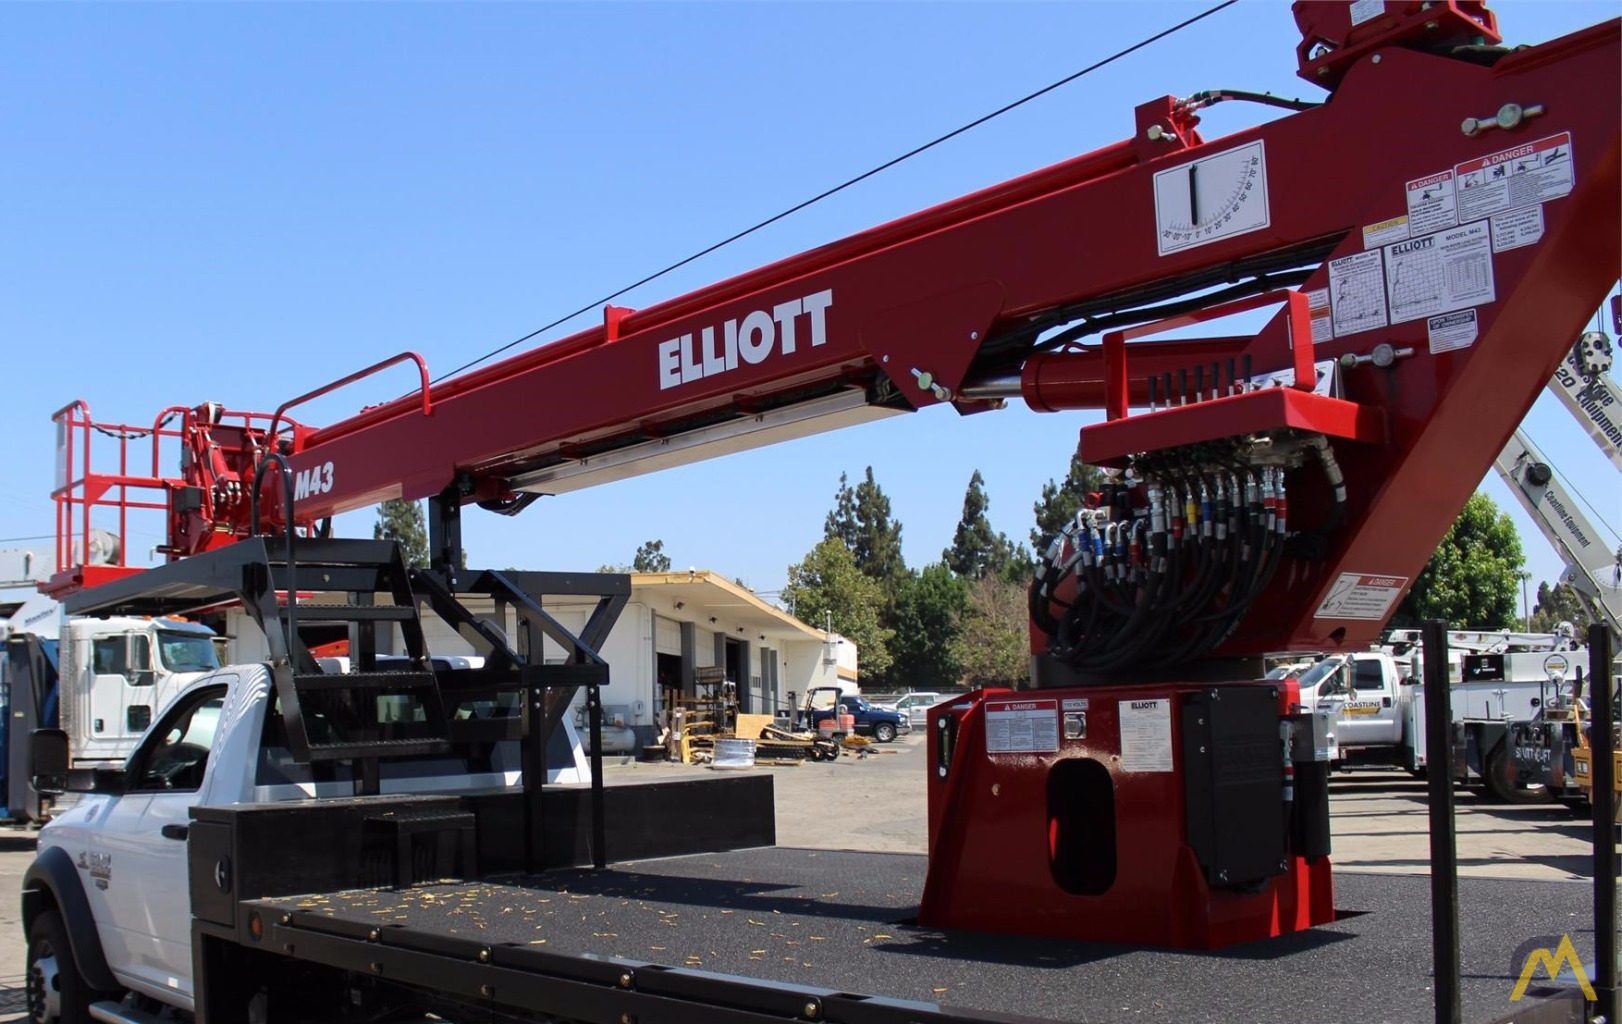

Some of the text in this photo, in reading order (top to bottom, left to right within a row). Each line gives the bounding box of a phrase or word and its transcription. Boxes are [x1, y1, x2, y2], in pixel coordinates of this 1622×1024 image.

[1491, 145, 1534, 164] DANGER
[1392, 236, 1435, 256] ELLIOTT
[1445, 232, 1467, 241] MODEL
[1331, 256, 1353, 266] ELLIOTT
[659, 288, 833, 390] ELLIOTT
[294, 461, 334, 501] M43
[1544, 490, 1592, 548] Coastline Equipment
[1012, 703, 1037, 711] DANGER
[1131, 701, 1158, 710] ELLIOTT
